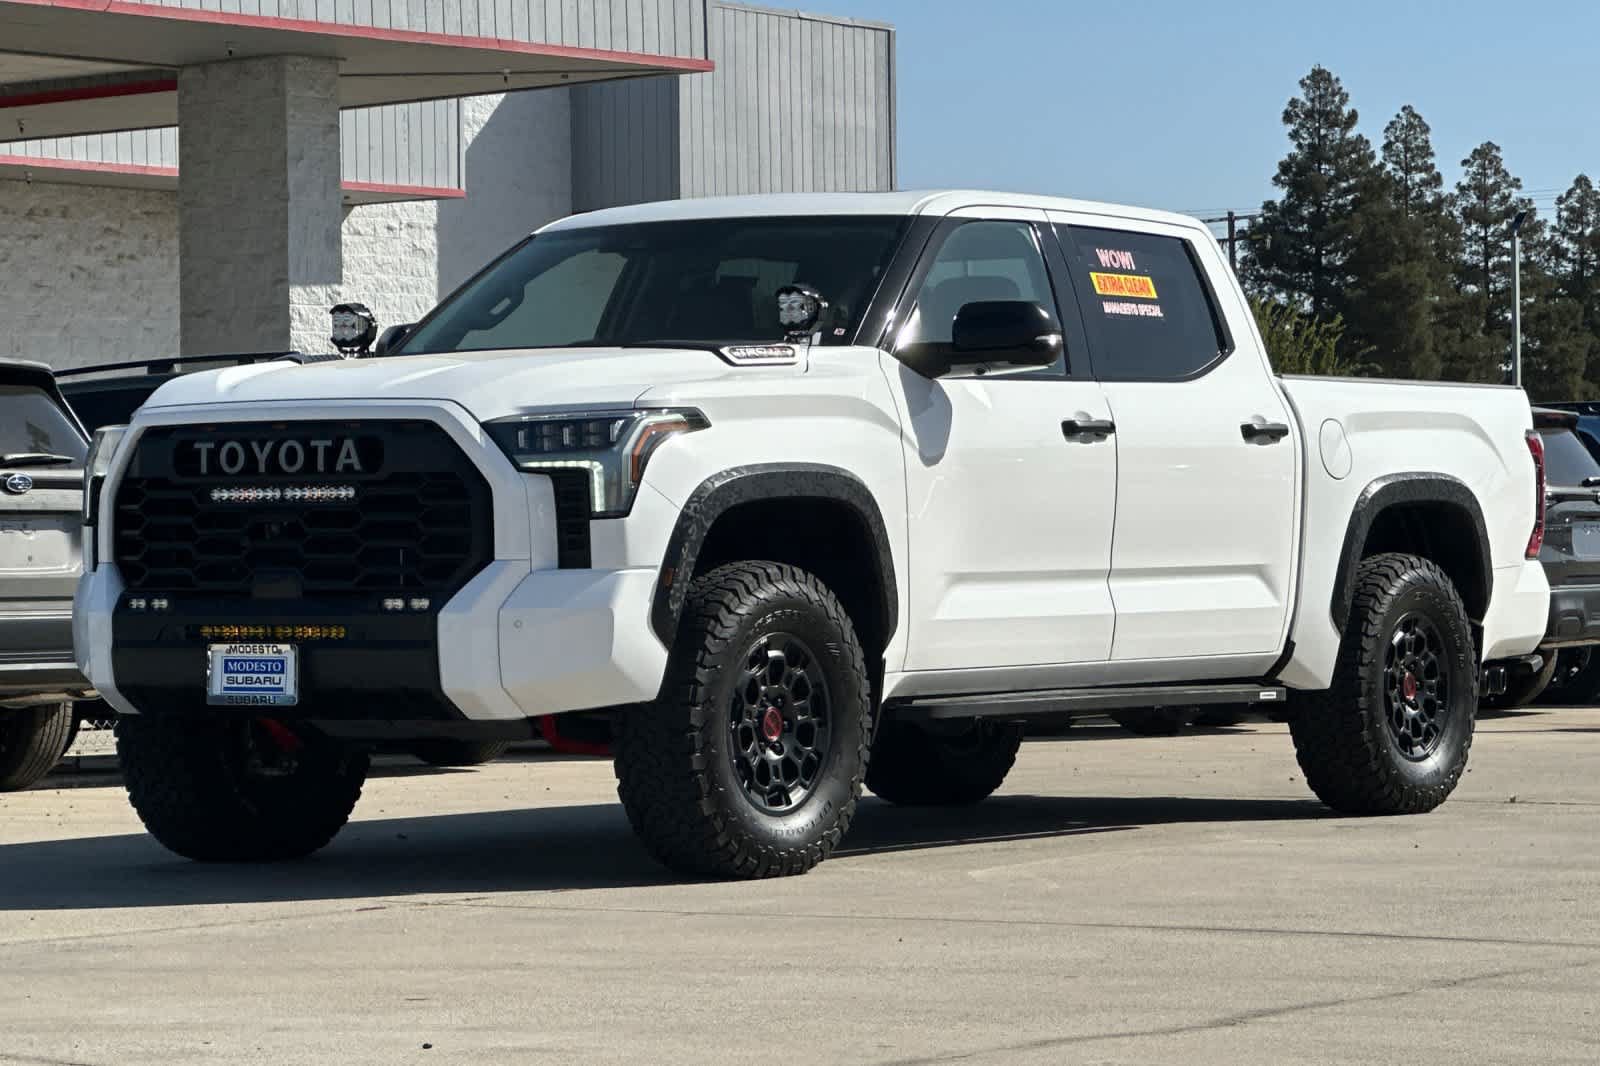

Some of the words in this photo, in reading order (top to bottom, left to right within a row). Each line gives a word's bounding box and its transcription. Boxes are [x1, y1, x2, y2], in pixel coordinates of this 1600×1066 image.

[193, 439, 362, 475] TOYOTA
[228, 644, 279, 655] MODESTO
[227, 661, 282, 672] MODESTO
[226, 676, 282, 686] SUBARU
[227, 695, 277, 705] SUBARU
